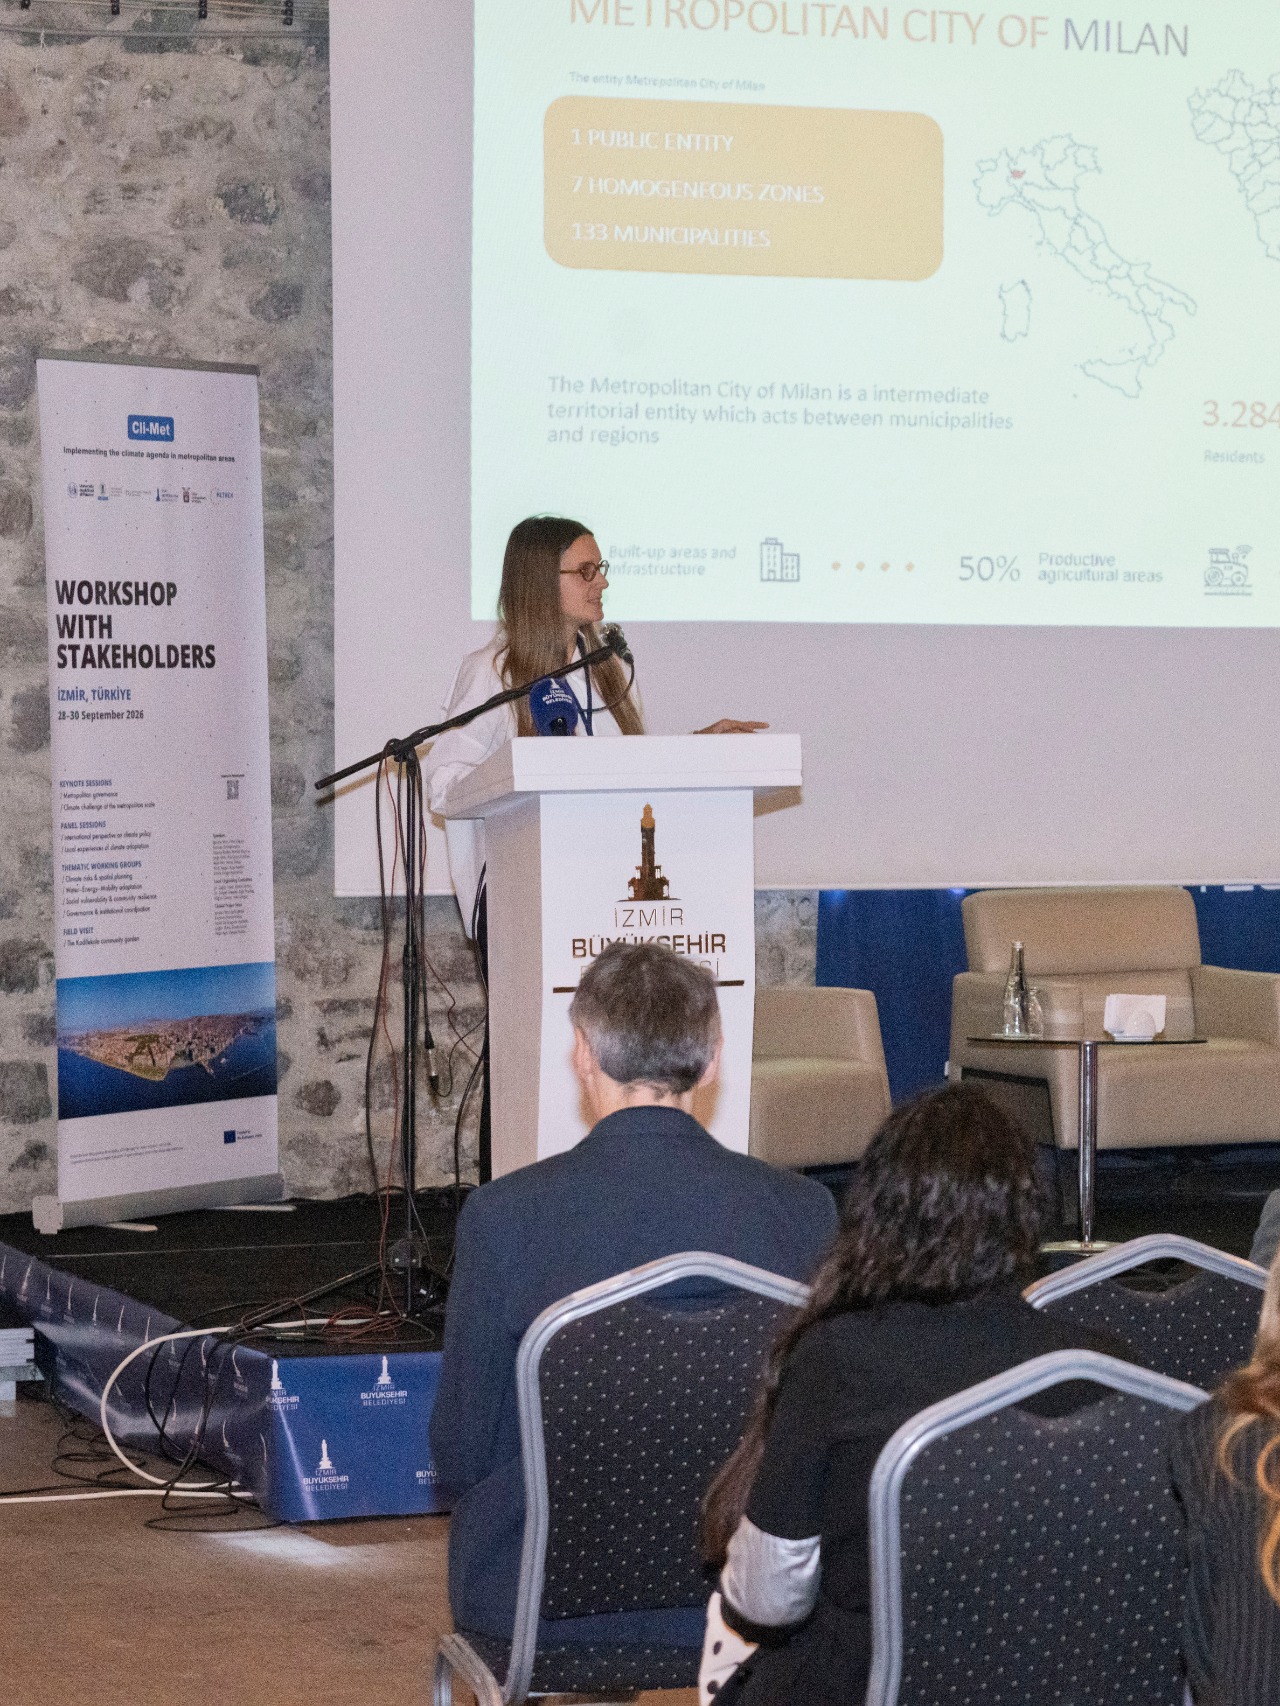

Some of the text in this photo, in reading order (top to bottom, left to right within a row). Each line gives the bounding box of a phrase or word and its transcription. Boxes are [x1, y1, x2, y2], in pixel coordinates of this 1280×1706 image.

[568, 0, 1188, 57] METROPOLITAN CITY OF MILAN
[569, 71, 765, 91] The entity Metropolitan City of Milan
[571, 128, 734, 151] 1 PUBLIC ENTITY
[571, 176, 825, 204] 7 HOMOGENEOUS ZONES
[571, 222, 771, 248] 133 MUNICIPALITIES
[548, 376, 990, 405] The Metropolitan City of Milan is a intermediate
[548, 401, 1014, 431] territorial entity which acts between municipalities
[131, 420, 171, 436] Cli-Met
[548, 426, 660, 447] and regions
[64, 446, 108, 458] Implementing
[109, 448, 120, 457] the
[121, 449, 145, 458] climate
[146, 451, 170, 460] agenda
[170, 451, 177, 460] in
[177, 452, 217, 462] metropolitan
[1203, 449, 1266, 464] Residents
[670, 546, 707, 559] areas
[711, 545, 737, 559] and
[1038, 552, 1116, 567] Productive
[958, 554, 1021, 582] 50%
[1038, 568, 1163, 585] agricultural areas
[55, 580, 178, 606] WORKSHOP
[56, 614, 112, 639] WITH
[57, 643, 216, 669] STAKEHOLDERS
[57, 685, 132, 703] İZMİR, TÜRKİYE
[58, 709, 144, 723] 28-30 September 2026
[86, 779, 112, 787] SESSIONS
[79, 820, 106, 829] SESSIONS
[119, 860, 142, 869] GROUPS
[614, 905, 684, 928] İZMİR
[571, 930, 727, 959] BÜEHİR
